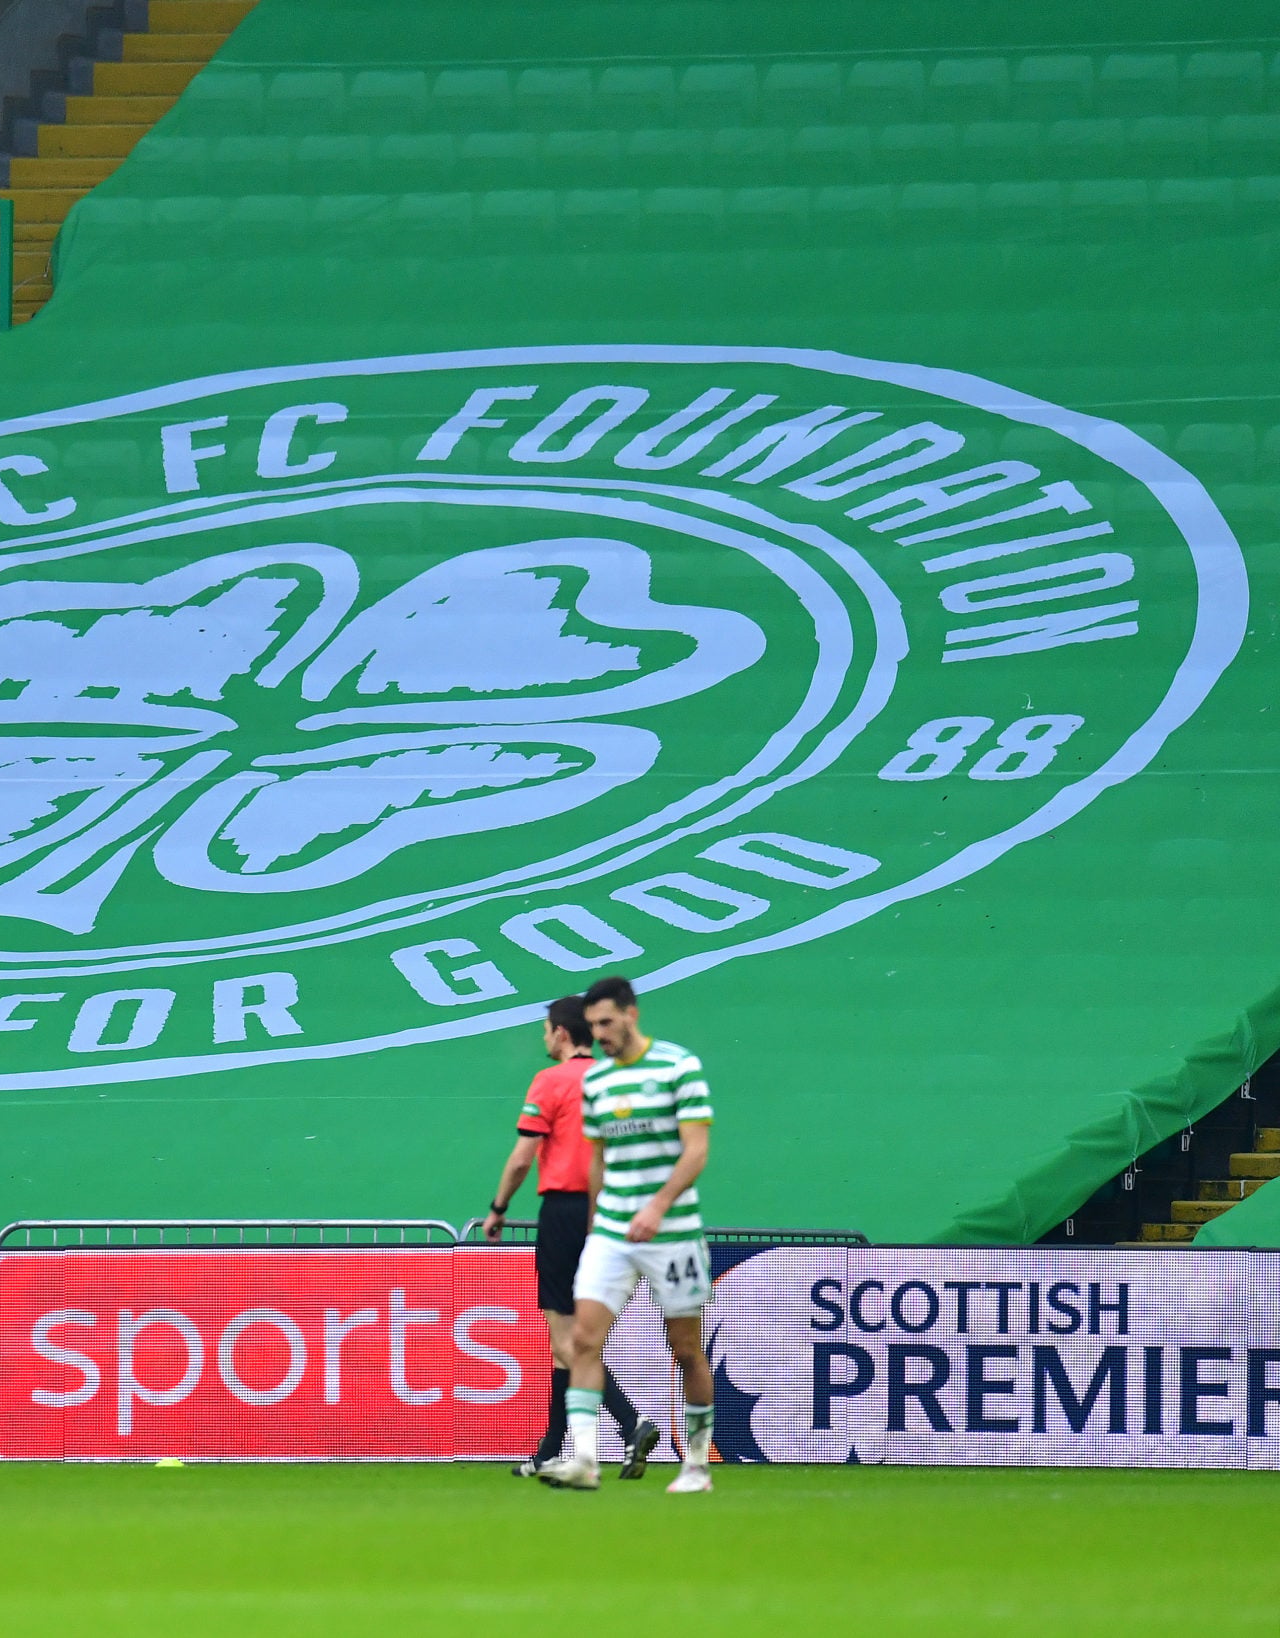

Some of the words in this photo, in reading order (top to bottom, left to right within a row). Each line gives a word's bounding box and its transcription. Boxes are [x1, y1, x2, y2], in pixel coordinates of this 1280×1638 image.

[161, 402, 347, 493] FC
[416, 385, 1140, 664] FOUNDATION
[878, 714, 1085, 782] 88
[390, 832, 880, 1006] GOOD
[666, 1255, 698, 1285] 44
[811, 1279, 1129, 1335] SCOTTISH
[31, 1288, 521, 1436] sports
